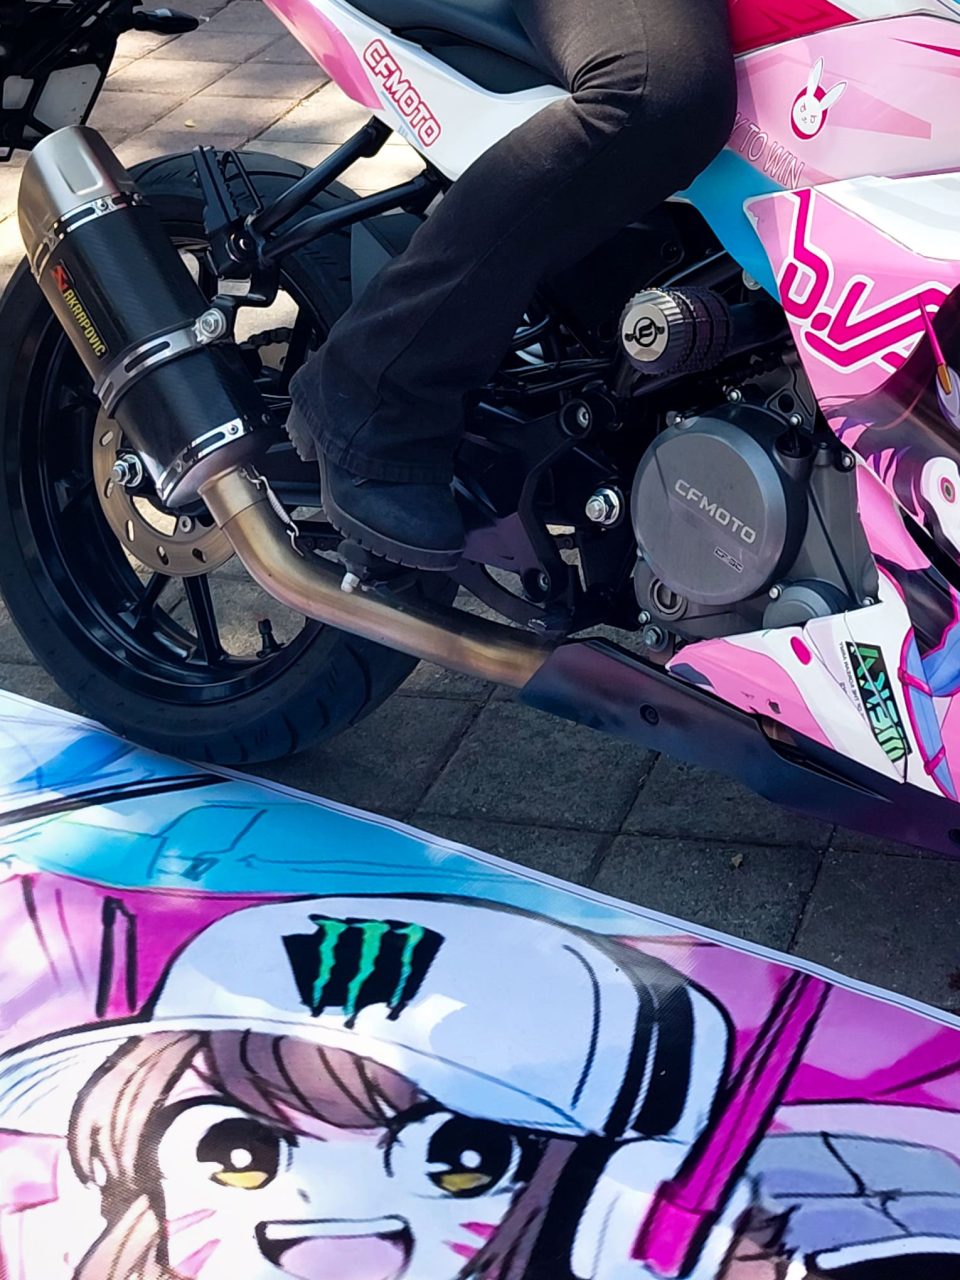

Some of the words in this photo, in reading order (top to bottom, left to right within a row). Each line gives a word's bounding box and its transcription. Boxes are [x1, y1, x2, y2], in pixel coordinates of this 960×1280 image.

[363, 39, 442, 148] CFMOTO
[740, 122, 768, 162] TO
[763, 140, 806, 190] WIN
[675, 479, 756, 544] CFMOTO
